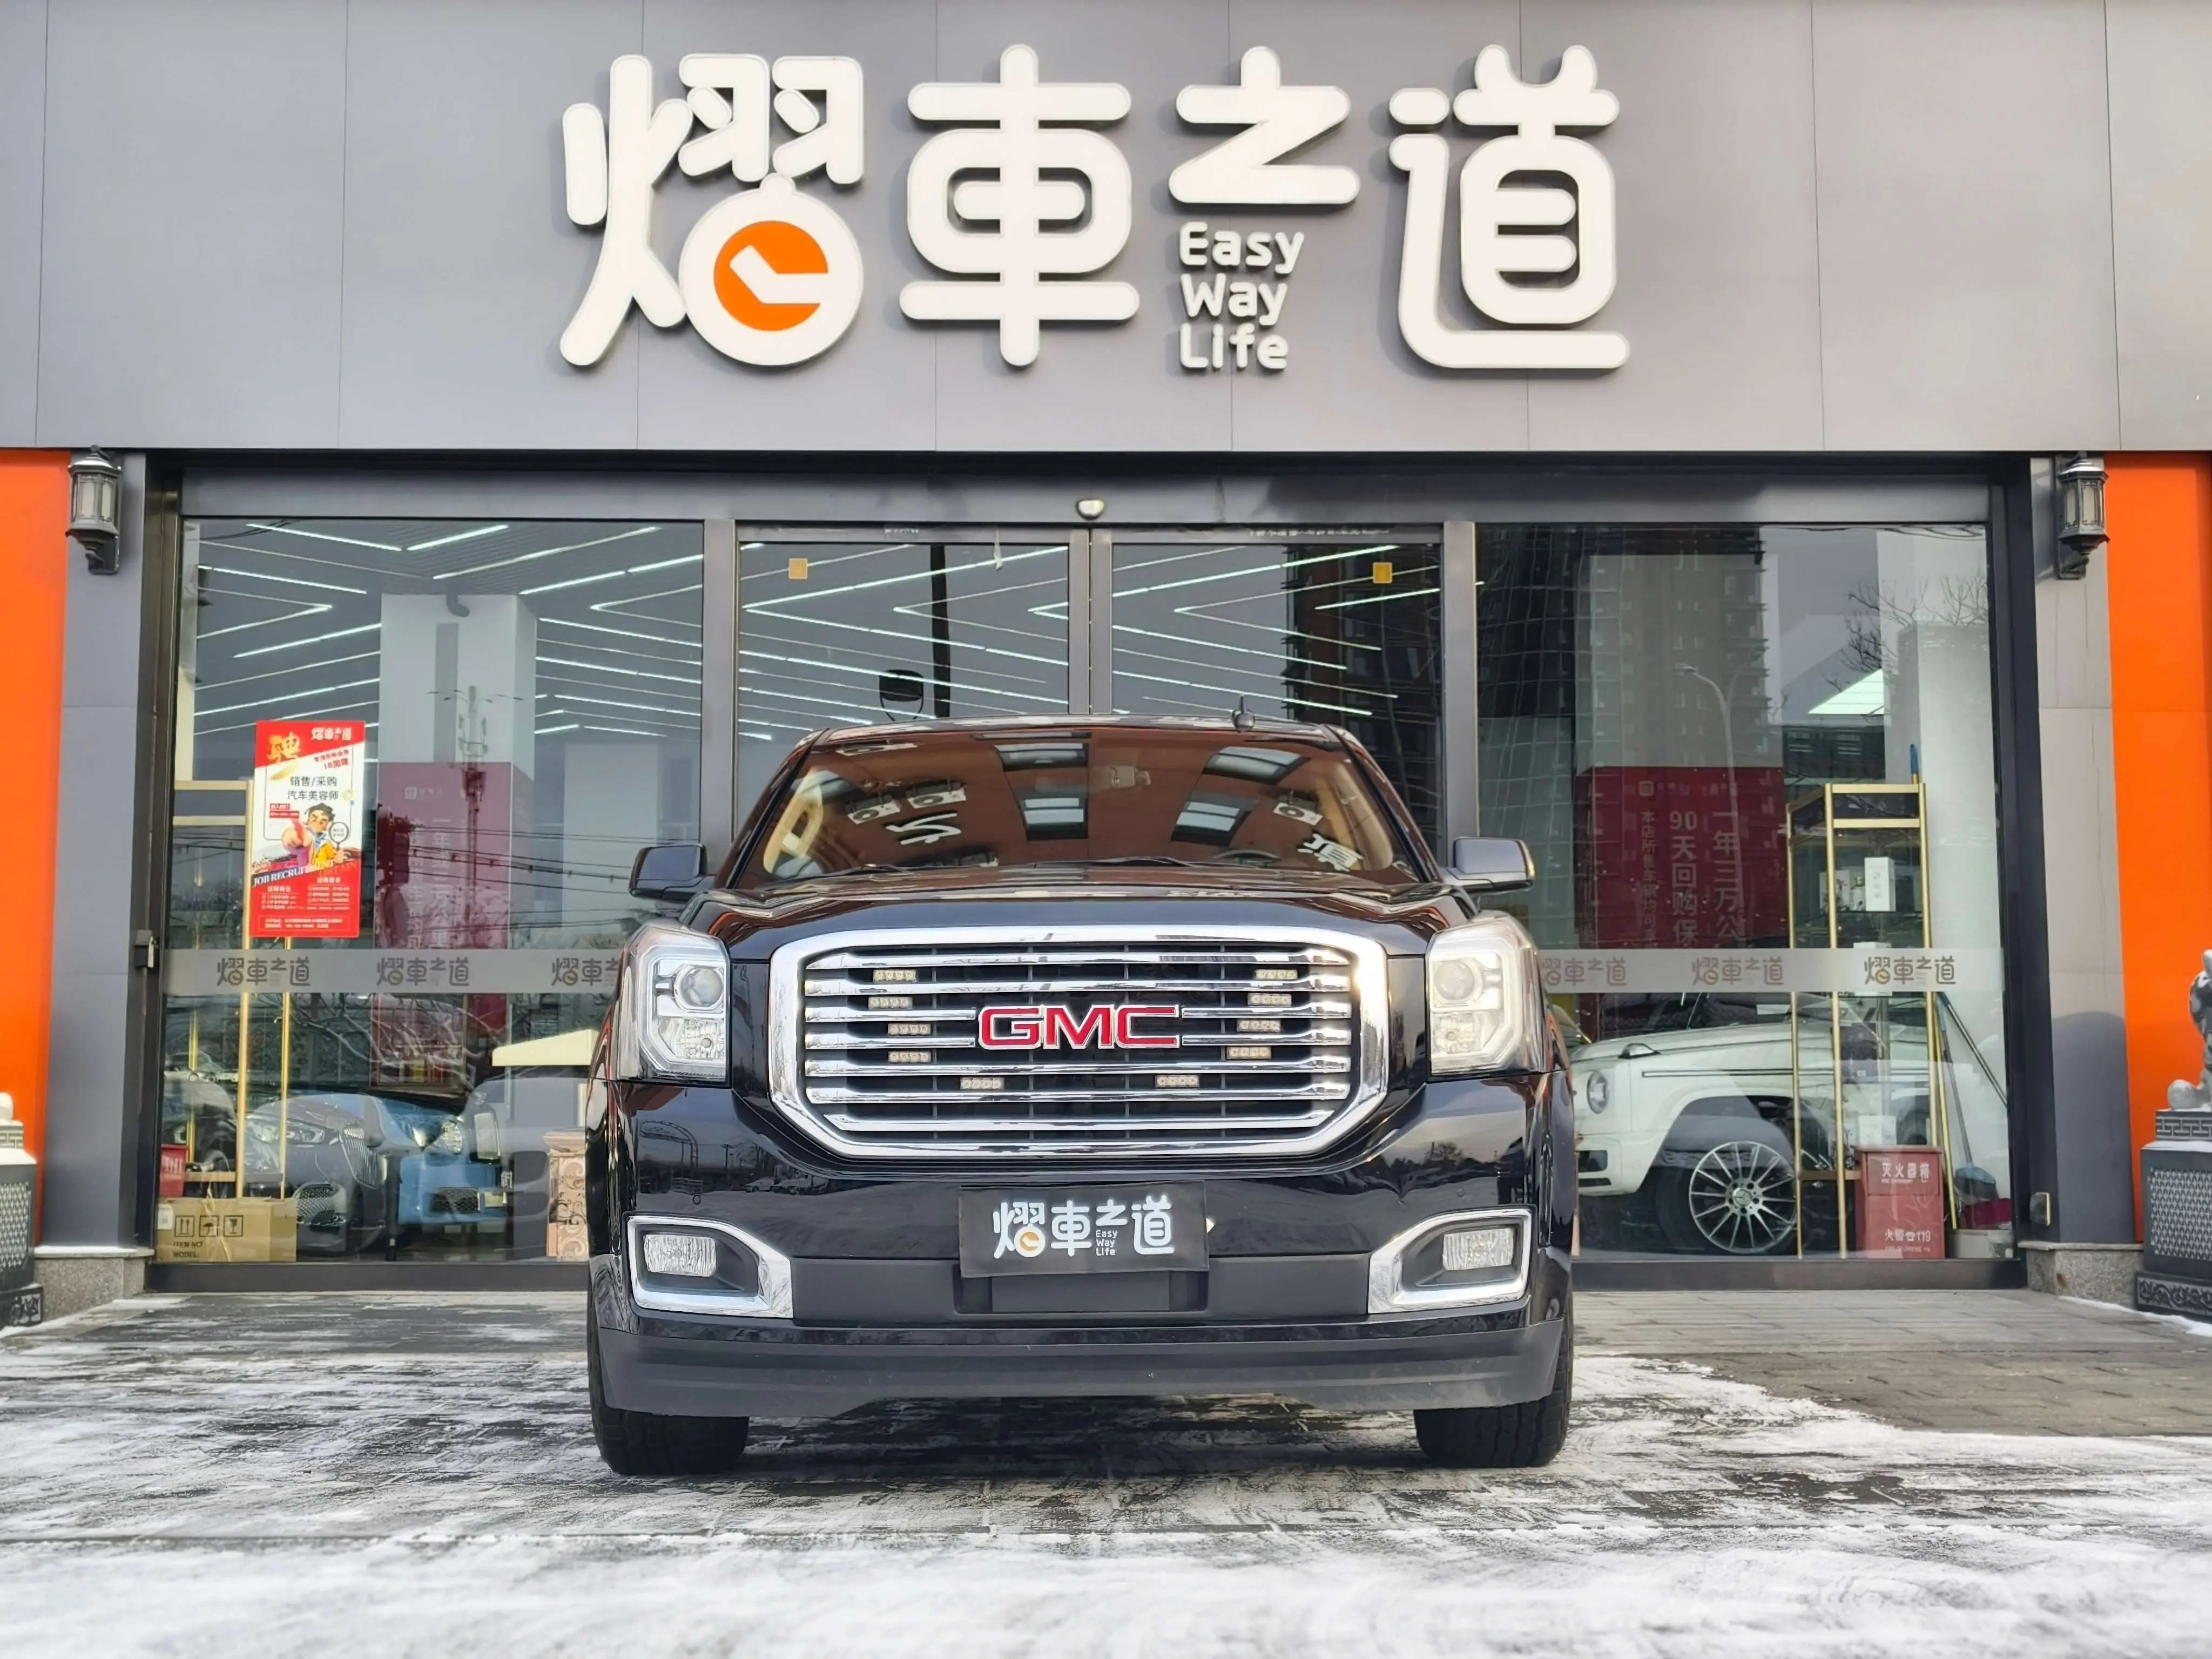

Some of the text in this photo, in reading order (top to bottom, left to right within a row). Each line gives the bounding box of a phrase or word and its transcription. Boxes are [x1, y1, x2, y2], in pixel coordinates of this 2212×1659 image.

[560, 44, 1630, 368] 熠車之道
[1180, 221, 1305, 274] Easy
[1180, 273, 1288, 326] Way
[1180, 323, 1289, 369] Life
[289, 775, 338, 787] 销售/采购
[287, 790, 339, 801] 汽车美容师
[979, 1004, 1179, 1049] GMC
[1096, 1230, 1117, 1238] Easy
[1096, 1239, 1115, 1247] Way
[1096, 1247, 1115, 1256] Life
